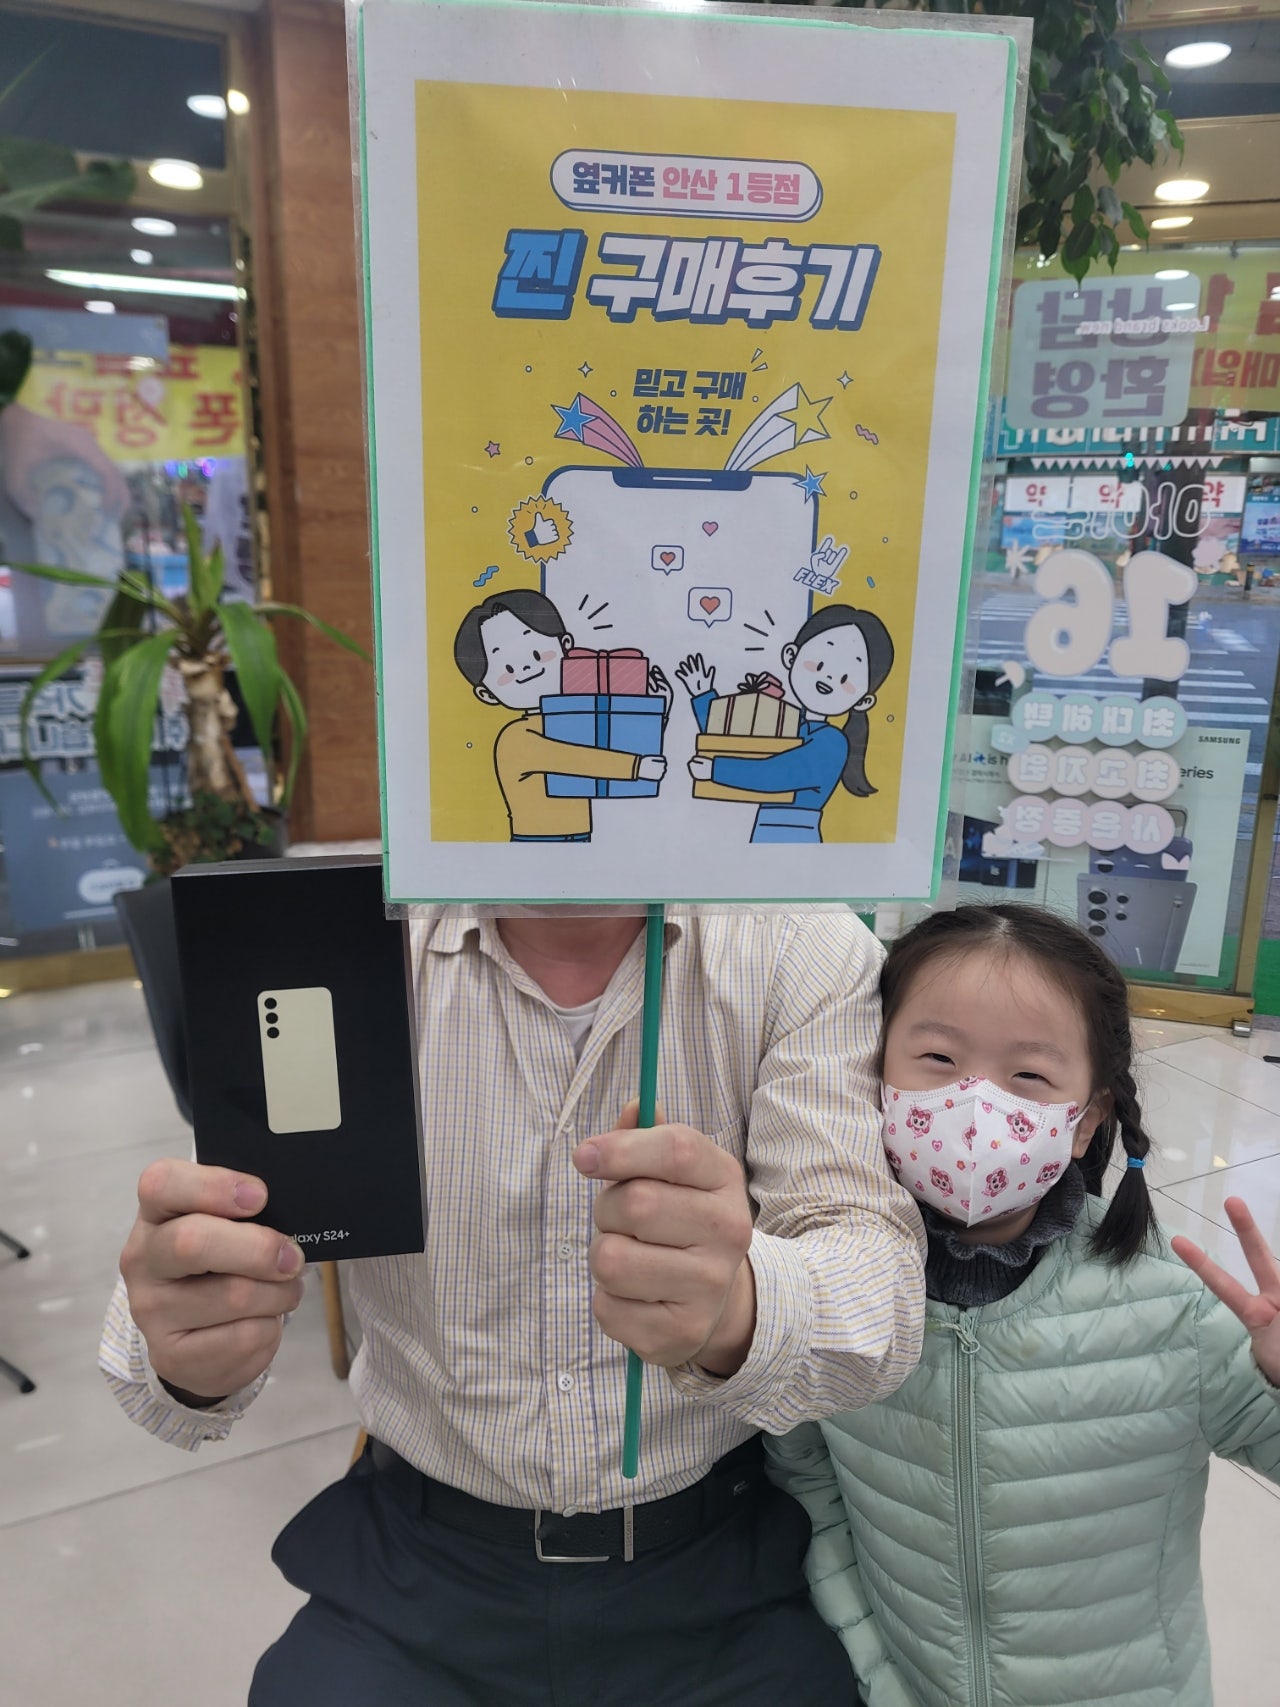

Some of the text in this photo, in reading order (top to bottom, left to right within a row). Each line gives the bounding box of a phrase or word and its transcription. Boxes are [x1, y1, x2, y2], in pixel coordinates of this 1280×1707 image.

[573, 161, 800, 206] 옆커폰 안산 1등점
[492, 229, 881, 331] 찐 구매후기
[632, 368, 747, 401] 믿고 구매
[636, 404, 732, 436] 하는 곳!
[793, 567, 840, 595] FLEX
[1198, 736, 1241, 745] SAMSUNG
[1179, 766, 1214, 779] eries
[292, 1230, 350, 1245] laxy S24+
